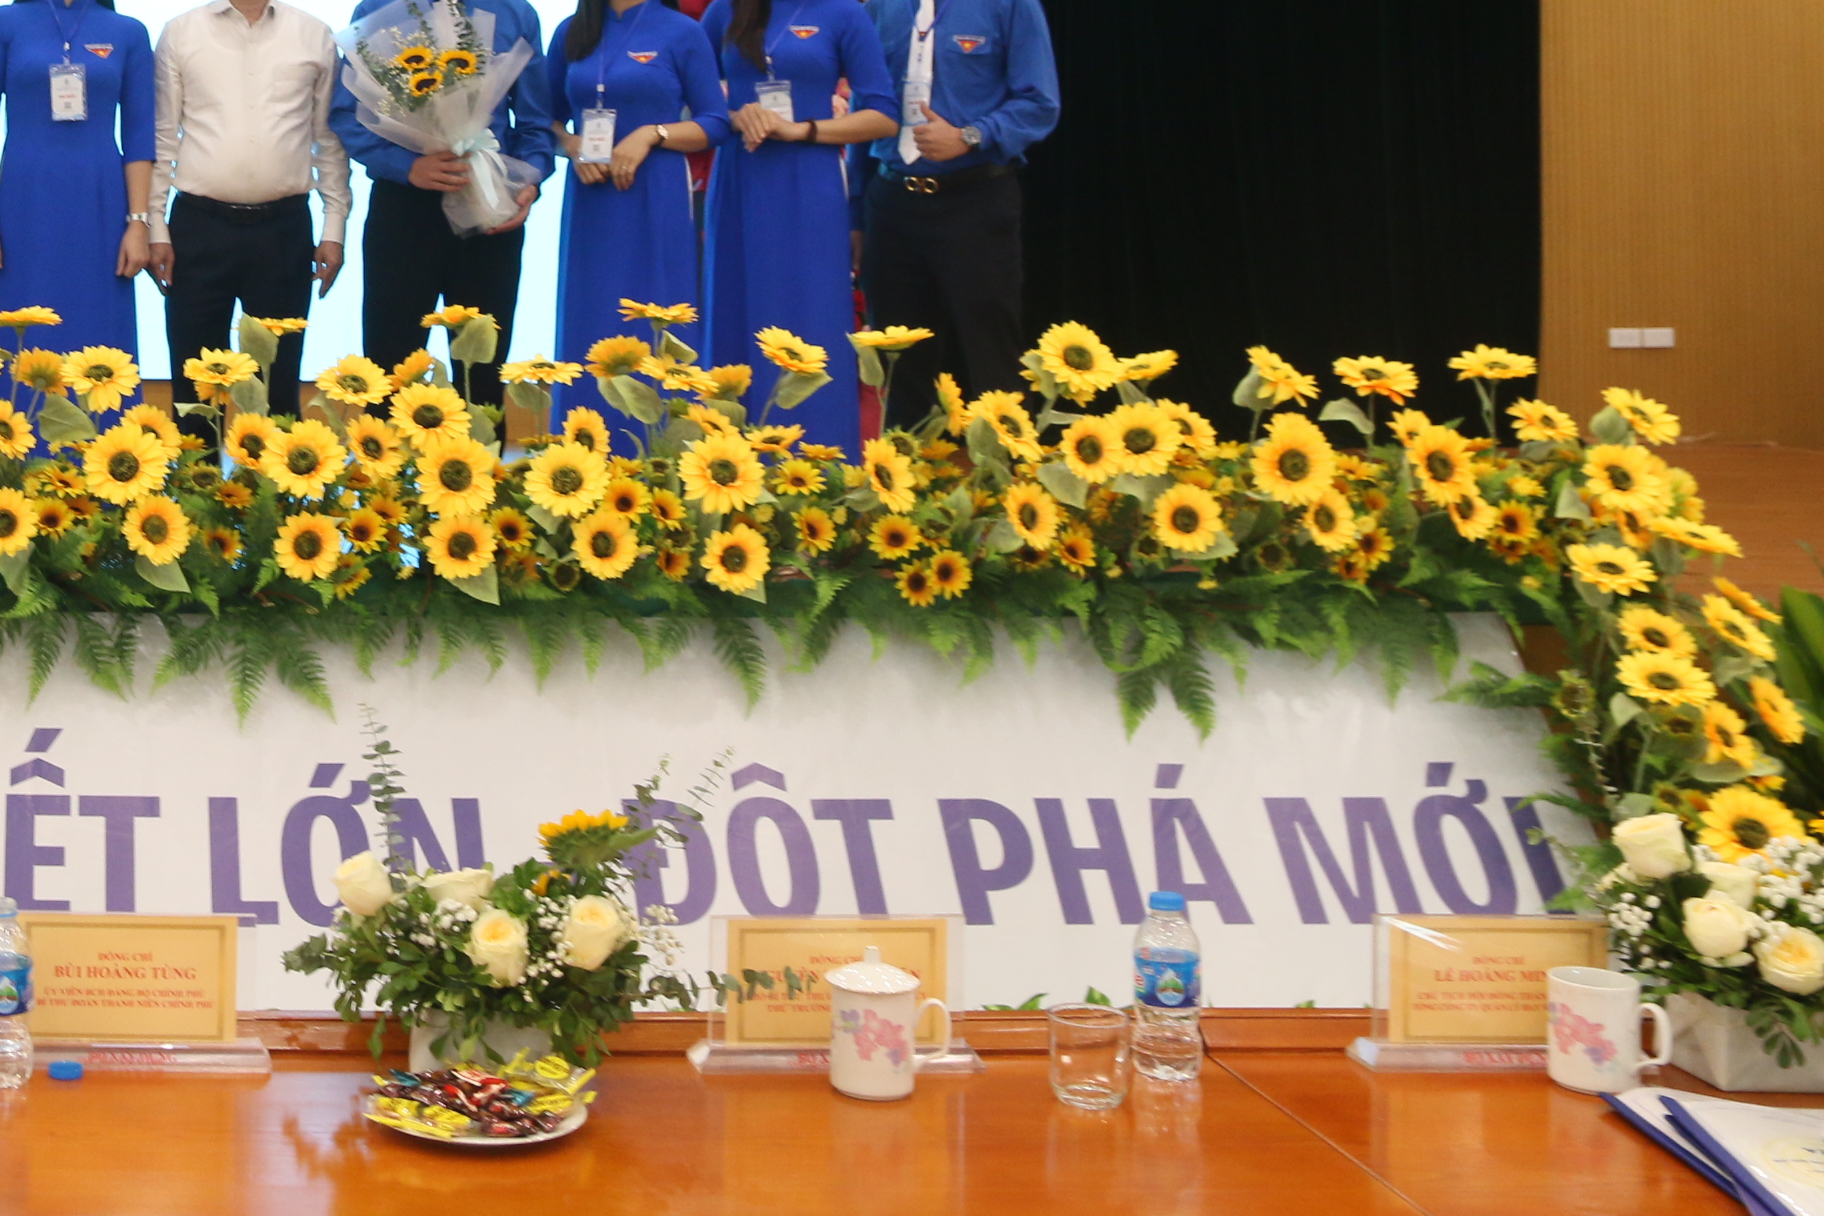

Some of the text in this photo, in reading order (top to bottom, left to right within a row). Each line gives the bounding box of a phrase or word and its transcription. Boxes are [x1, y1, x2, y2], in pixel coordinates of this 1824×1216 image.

[207, 762, 485, 928] LỚN
[936, 762, 1255, 926] PHÁ
[1261, 761, 1578, 925] MỚI
[53, 963, 198, 981] BÙI HOÀNG TÙNG
